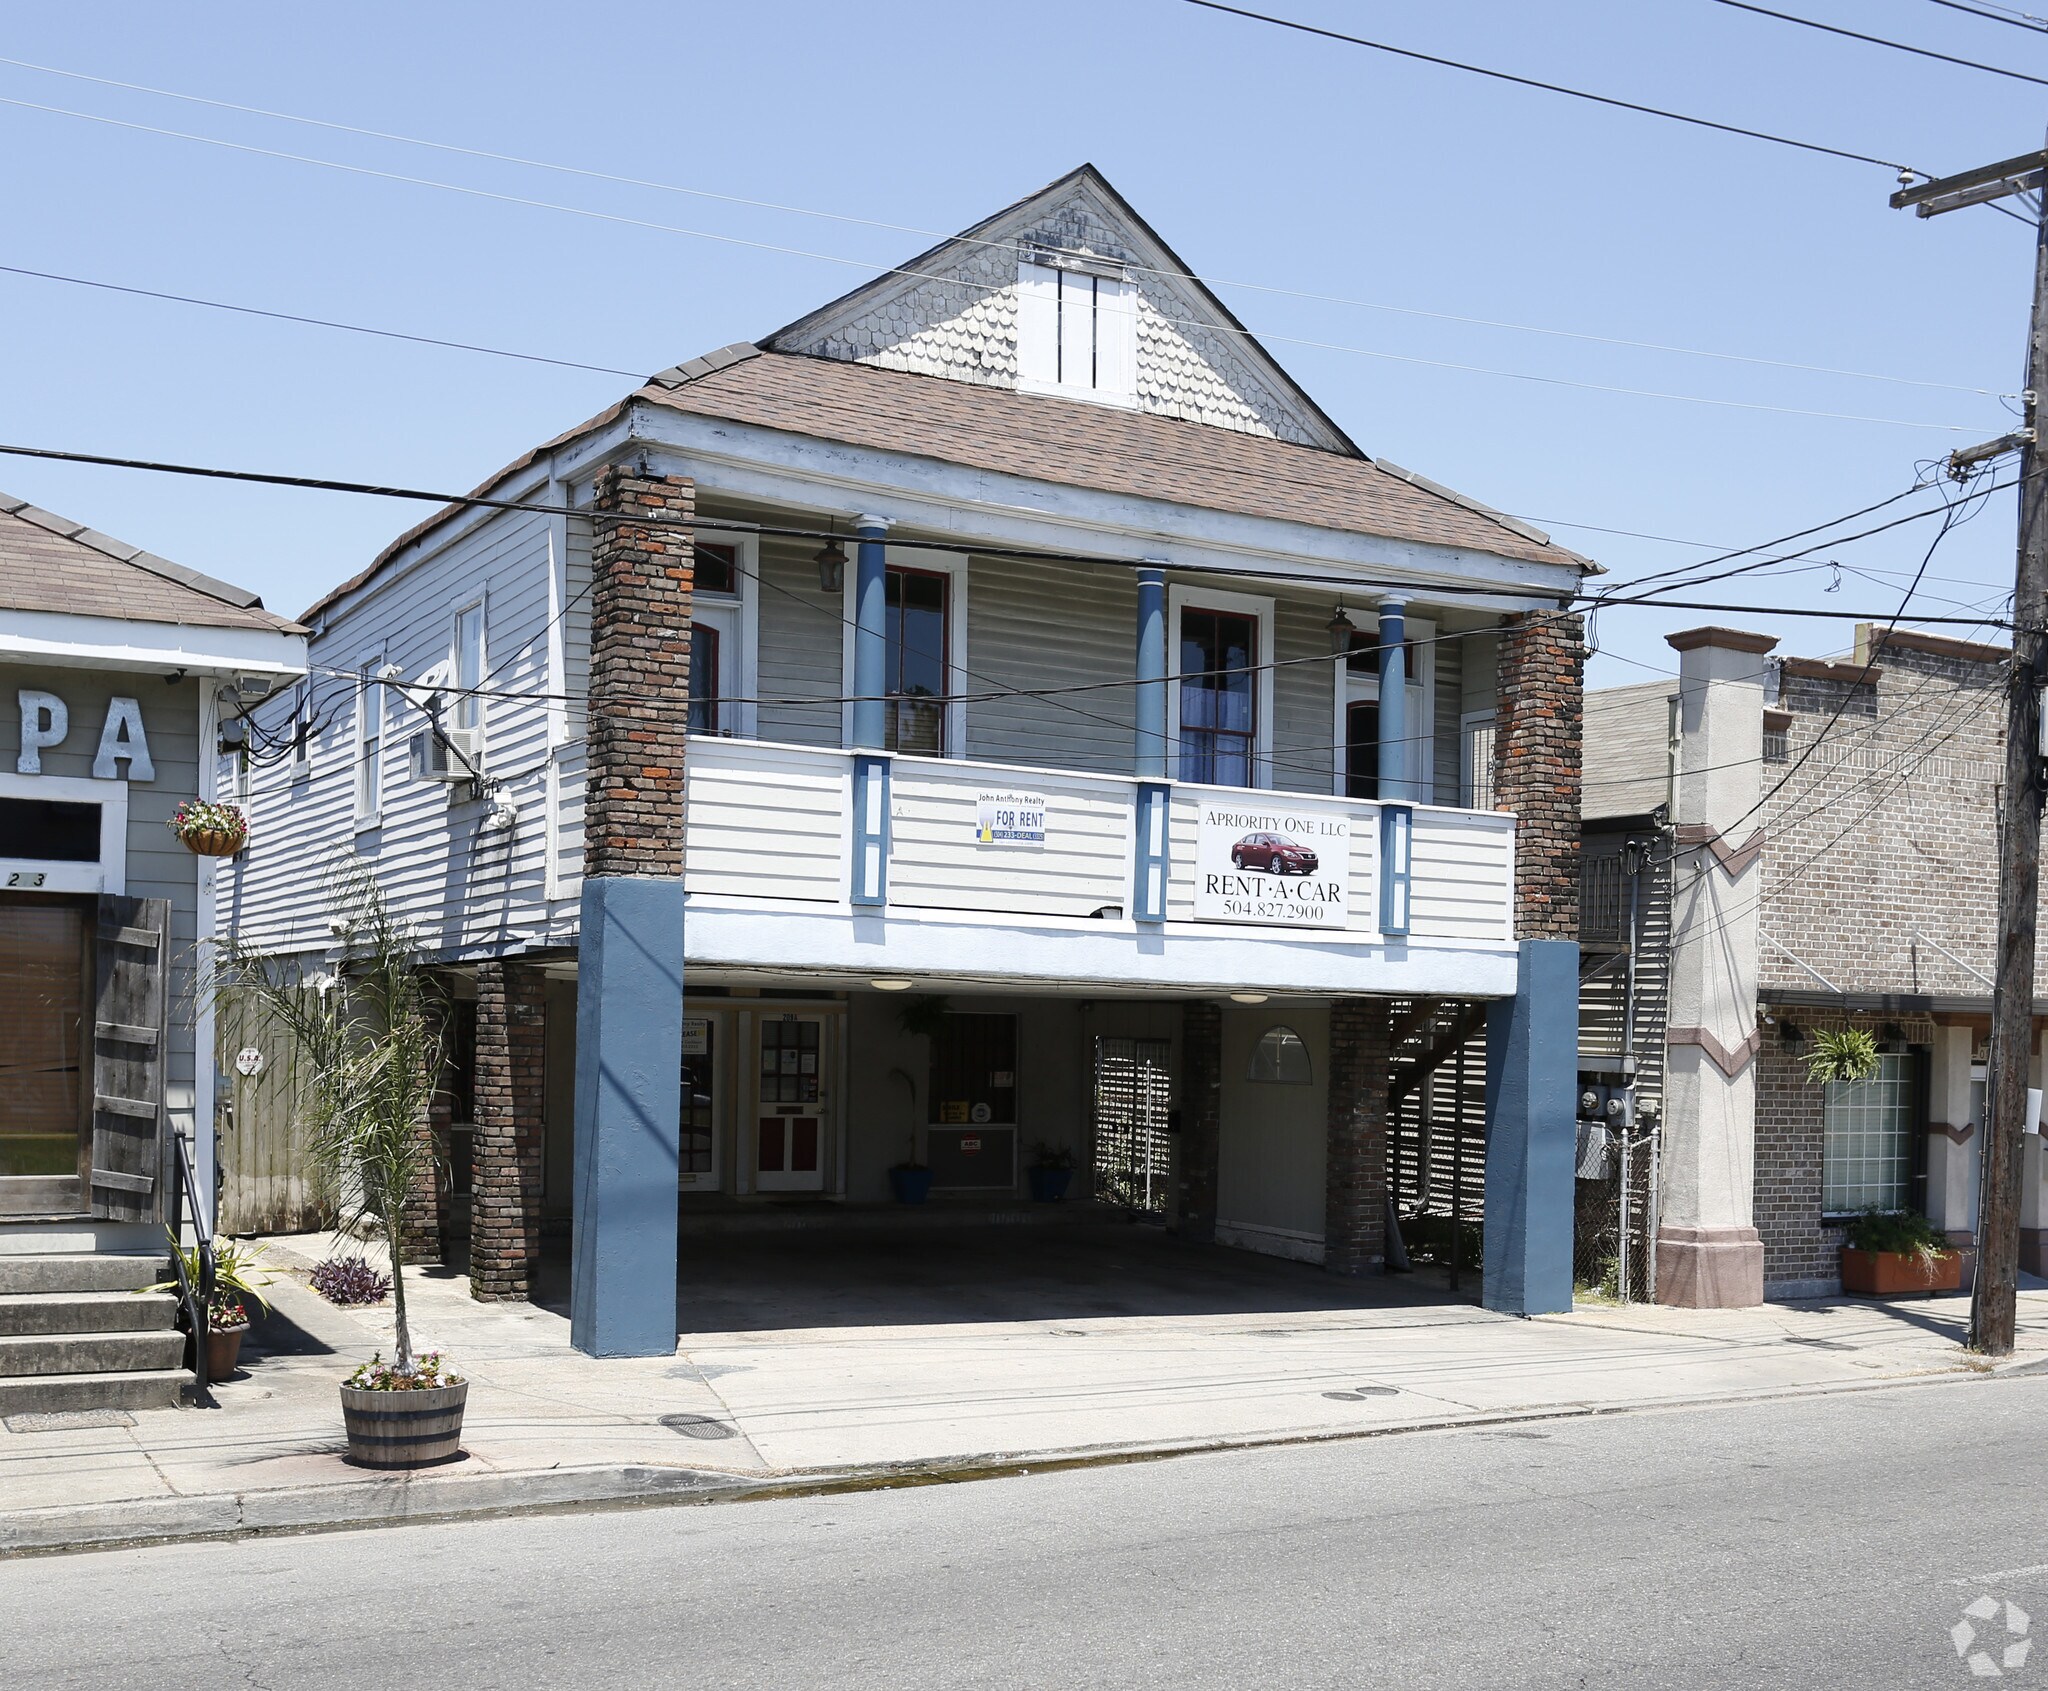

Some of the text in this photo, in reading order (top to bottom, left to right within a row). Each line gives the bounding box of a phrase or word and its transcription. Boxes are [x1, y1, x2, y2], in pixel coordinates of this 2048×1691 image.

[17, 689, 155, 782] PA
[979, 794, 1045, 806] John Anthony Realty
[996, 811, 1043, 827] FOR RENT
[1205, 811, 1347, 837] APRIORITY ONE LLC
[1223, 900, 1324, 920] 504.827.2900
